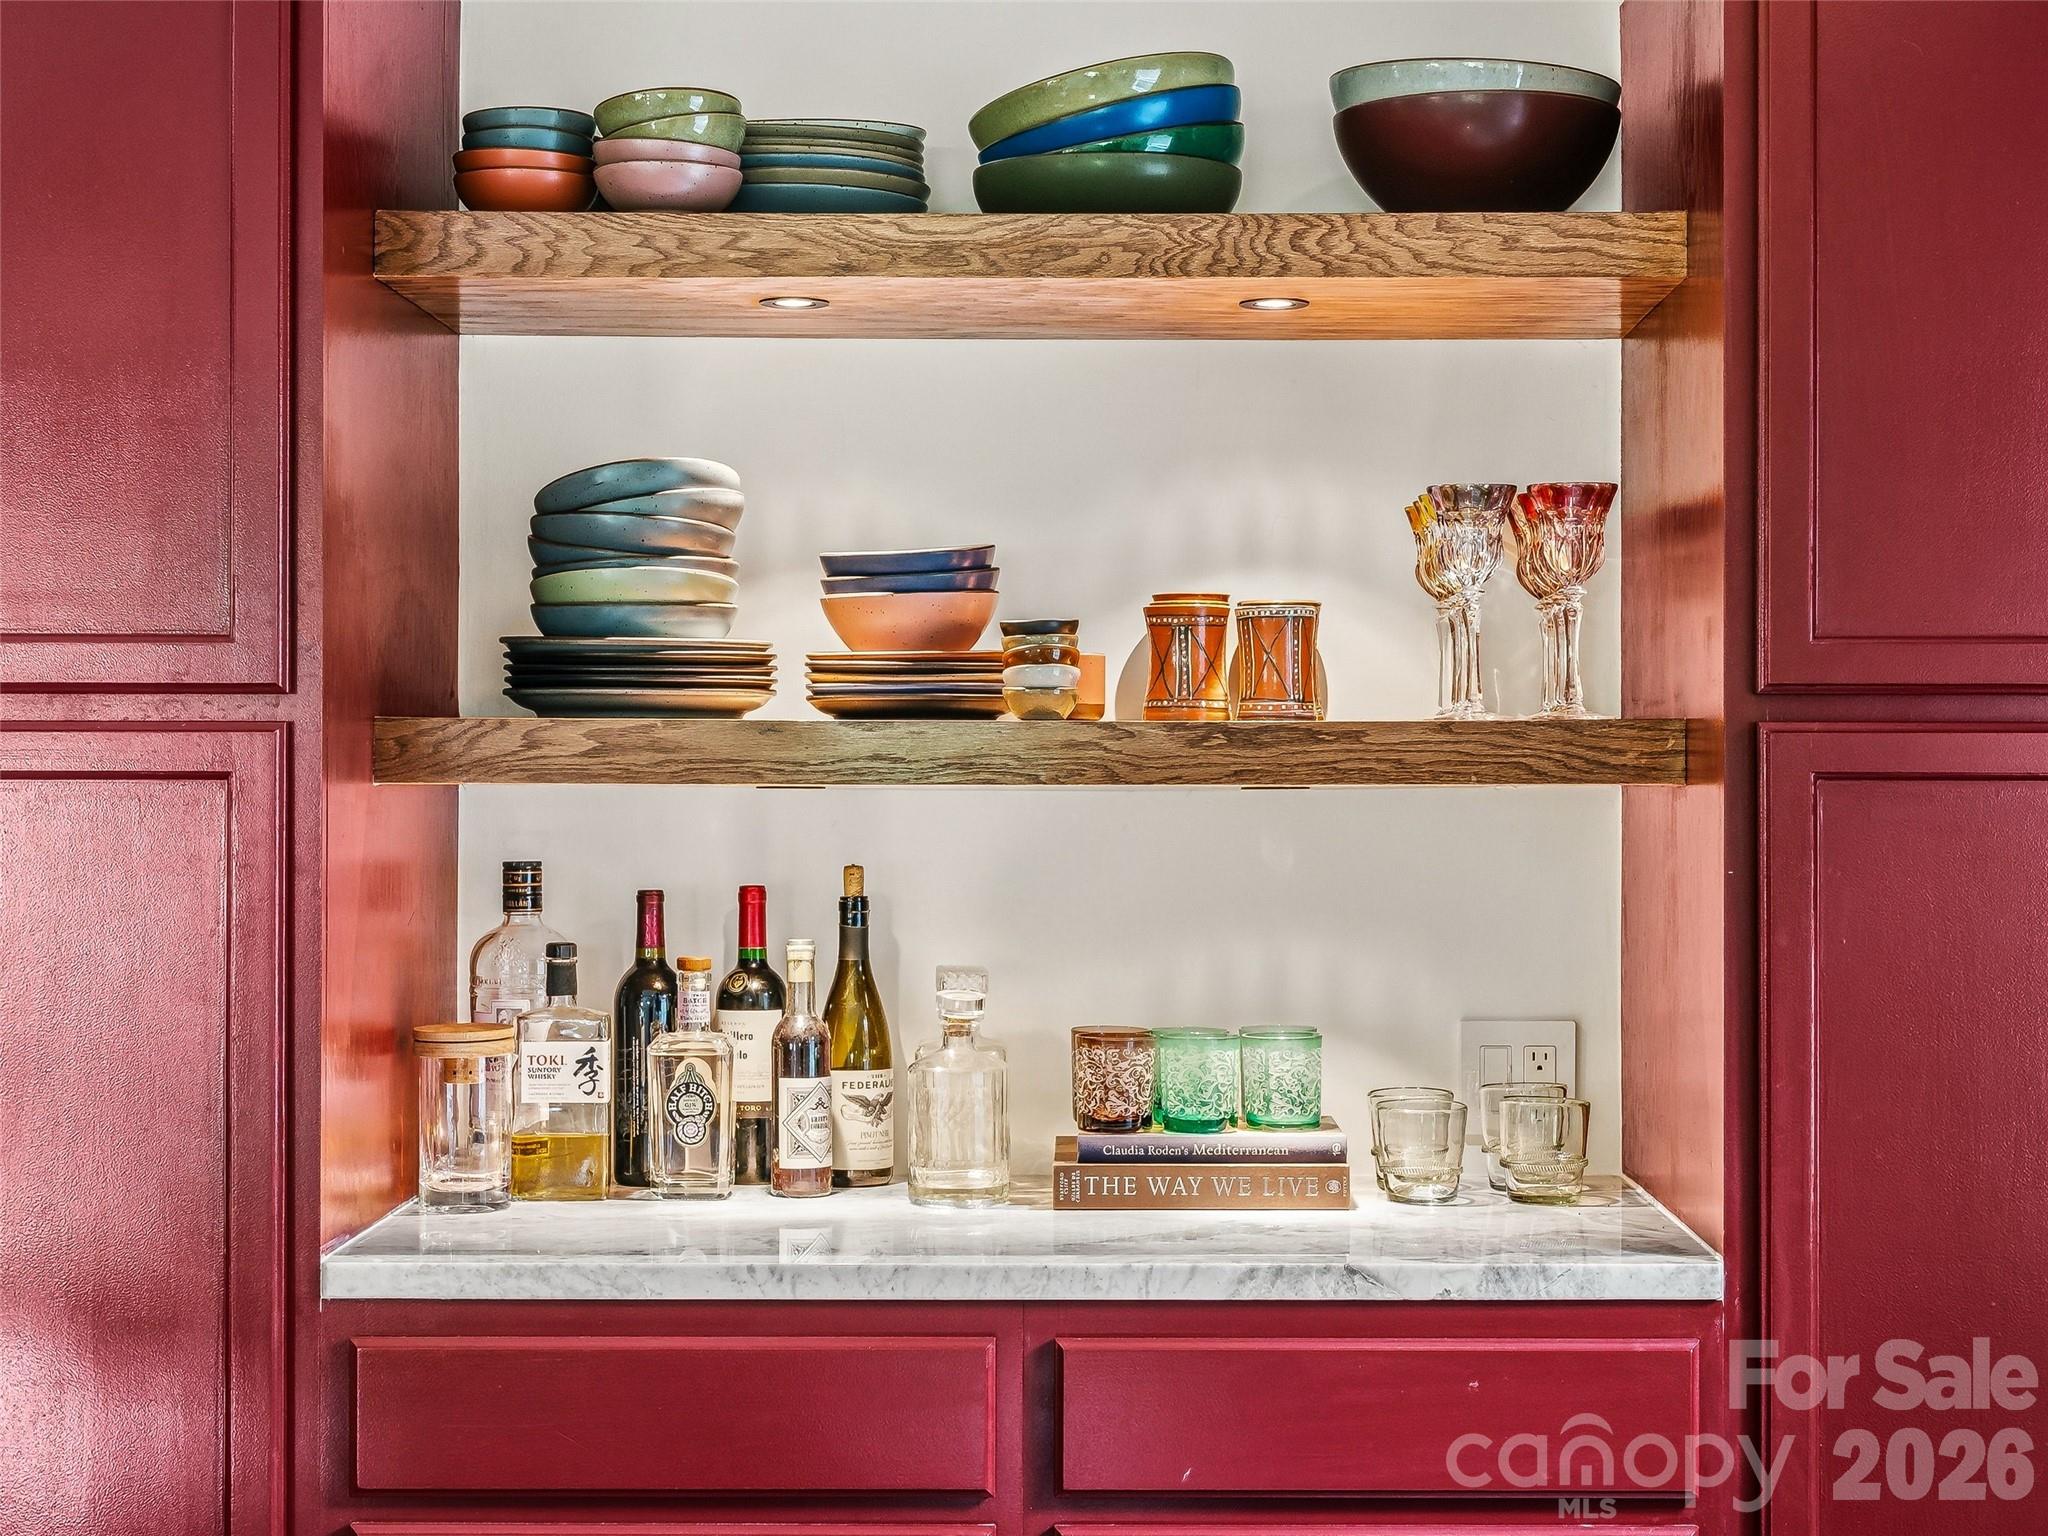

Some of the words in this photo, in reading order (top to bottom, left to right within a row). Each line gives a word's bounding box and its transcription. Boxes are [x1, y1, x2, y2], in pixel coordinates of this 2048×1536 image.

[527, 1054, 564, 1066] TOKI
[573, 1046, 604, 1096] 季
[668, 1084, 687, 1111] HALF
[689, 1083, 713, 1111] HITCH
[1102, 1145, 1145, 1155] Claudia
[1147, 1145, 1189, 1155] Roden's
[1192, 1143, 1289, 1155] Mediterranean
[1084, 1176, 1137, 1196] THE
[1146, 1176, 1204, 1196] WAY
[1211, 1176, 1252, 1197] WE
[1262, 1176, 1320, 1197] LIVE
